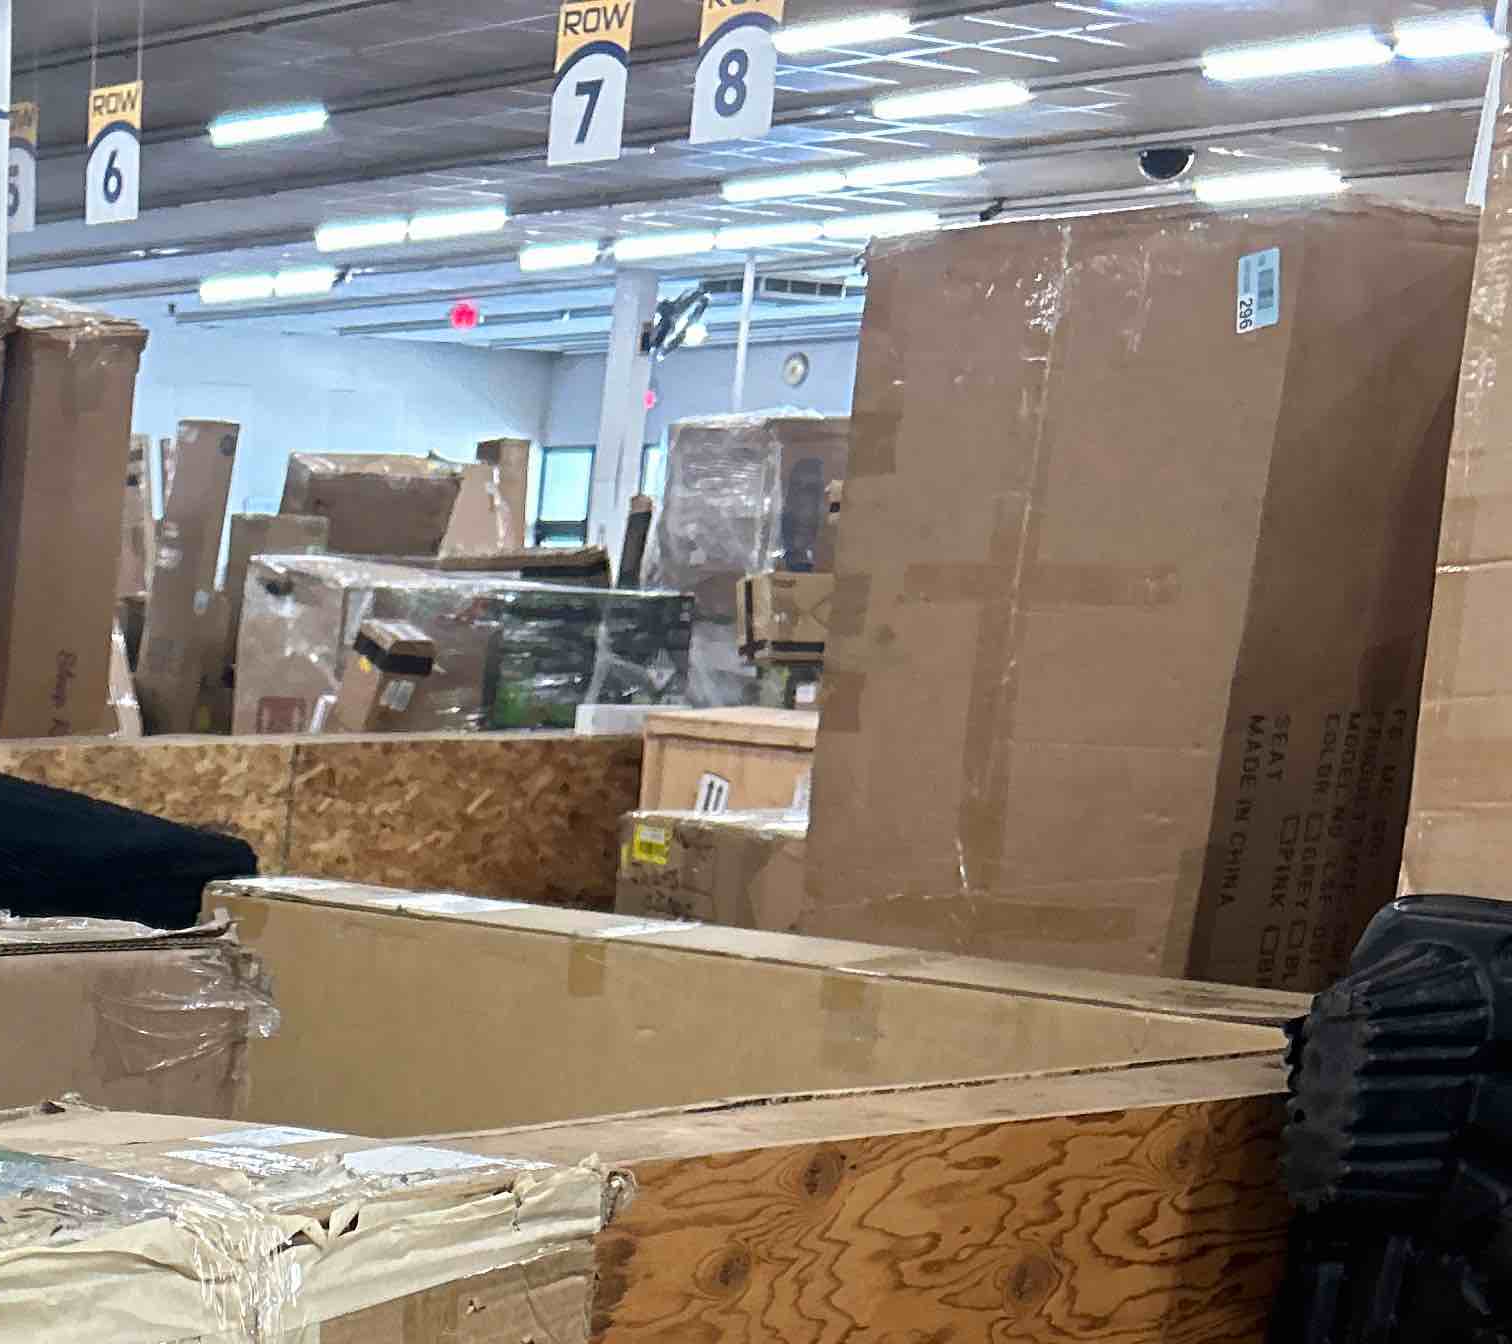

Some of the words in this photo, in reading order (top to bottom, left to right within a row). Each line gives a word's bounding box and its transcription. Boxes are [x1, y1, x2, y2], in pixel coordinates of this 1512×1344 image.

[563, 2, 630, 36] ROW
[92, 89, 139, 117] ROW
[573, 78, 605, 145] 7
[714, 48, 749, 118] 8
[103, 149, 123, 204] 6
[1239, 298, 1254, 331] 296
[1240, 715, 1265, 789] MADE
[1266, 714, 1292, 783] SEAT
[1233, 800, 1254, 824] IN
[1217, 832, 1247, 909] CHINA
